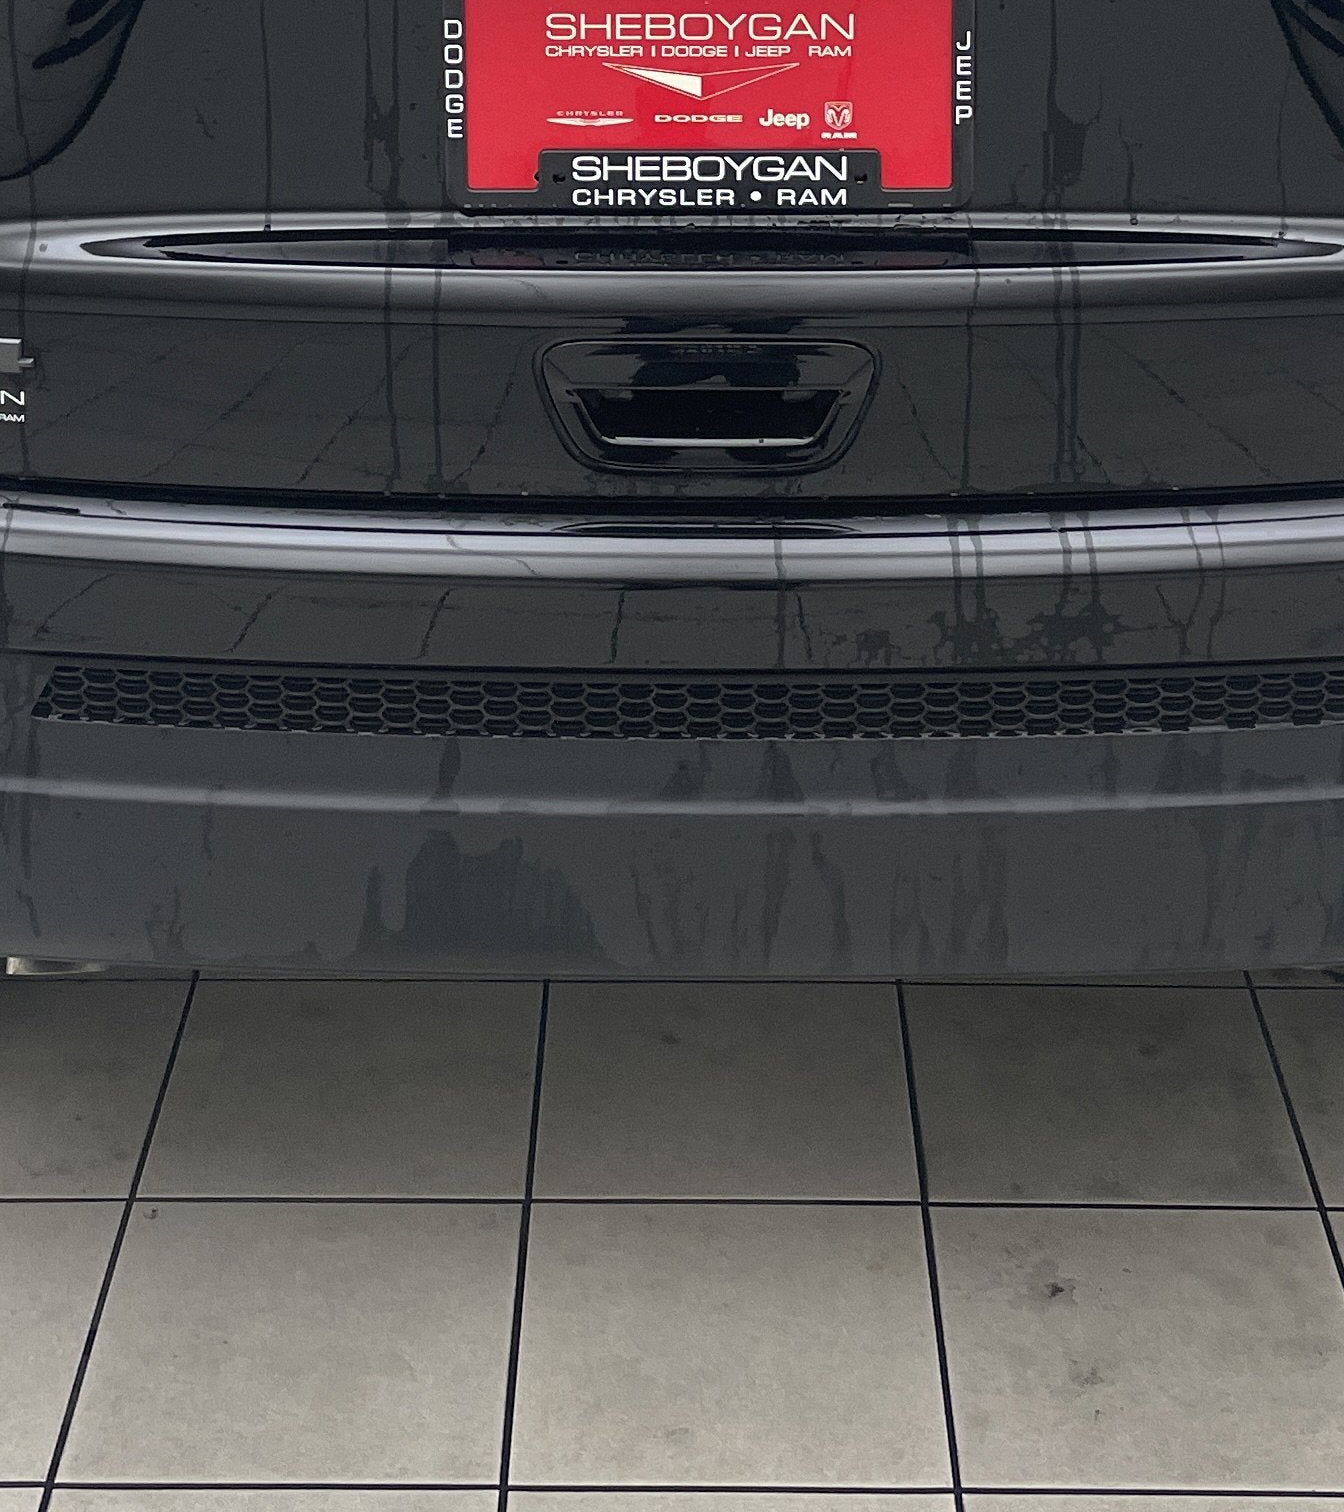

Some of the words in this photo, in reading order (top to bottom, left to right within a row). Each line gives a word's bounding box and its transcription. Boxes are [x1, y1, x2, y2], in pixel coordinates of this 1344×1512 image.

[545, 13, 855, 40] SHEBOYGAN
[545, 45, 643, 57] CHRYSLER
[661, 45, 728, 57] DODGE
[745, 45, 791, 57] JEEP
[808, 45, 852, 57] RAM
[443, 19, 464, 139] DODGE
[955, 31, 973, 125] JEEP
[759, 109, 810, 129] Jeep
[572, 155, 847, 181] SHEBOYGAN
[572, 188, 735, 206] CHRYSLER
[777, 188, 847, 206] RAM
